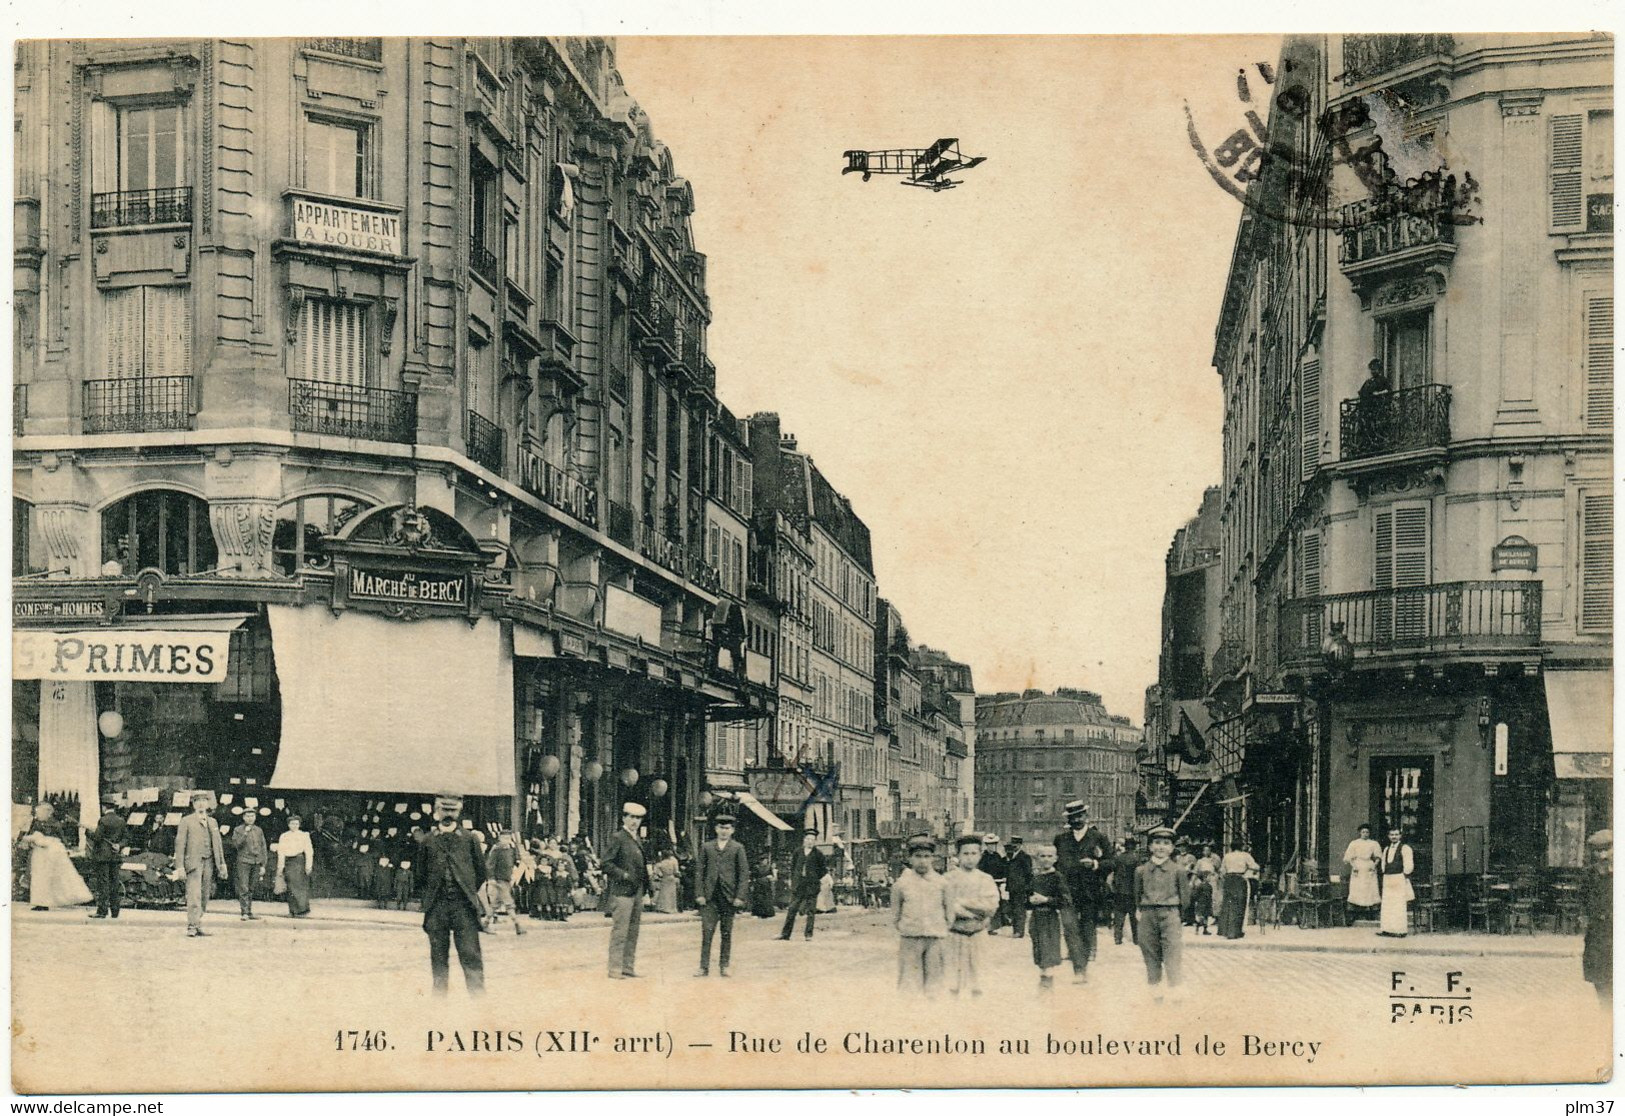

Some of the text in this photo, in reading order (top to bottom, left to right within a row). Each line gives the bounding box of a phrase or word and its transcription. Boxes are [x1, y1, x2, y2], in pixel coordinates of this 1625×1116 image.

[297, 203, 397, 238] APPARTEMENT
[303, 226, 393, 252] A LOUER
[403, 573, 415, 581] AU
[408, 585, 418, 598] DE
[419, 580, 463, 601] BERCY
[62, 602, 103, 616] HOMMES
[50, 637, 214, 676] PRIMES
